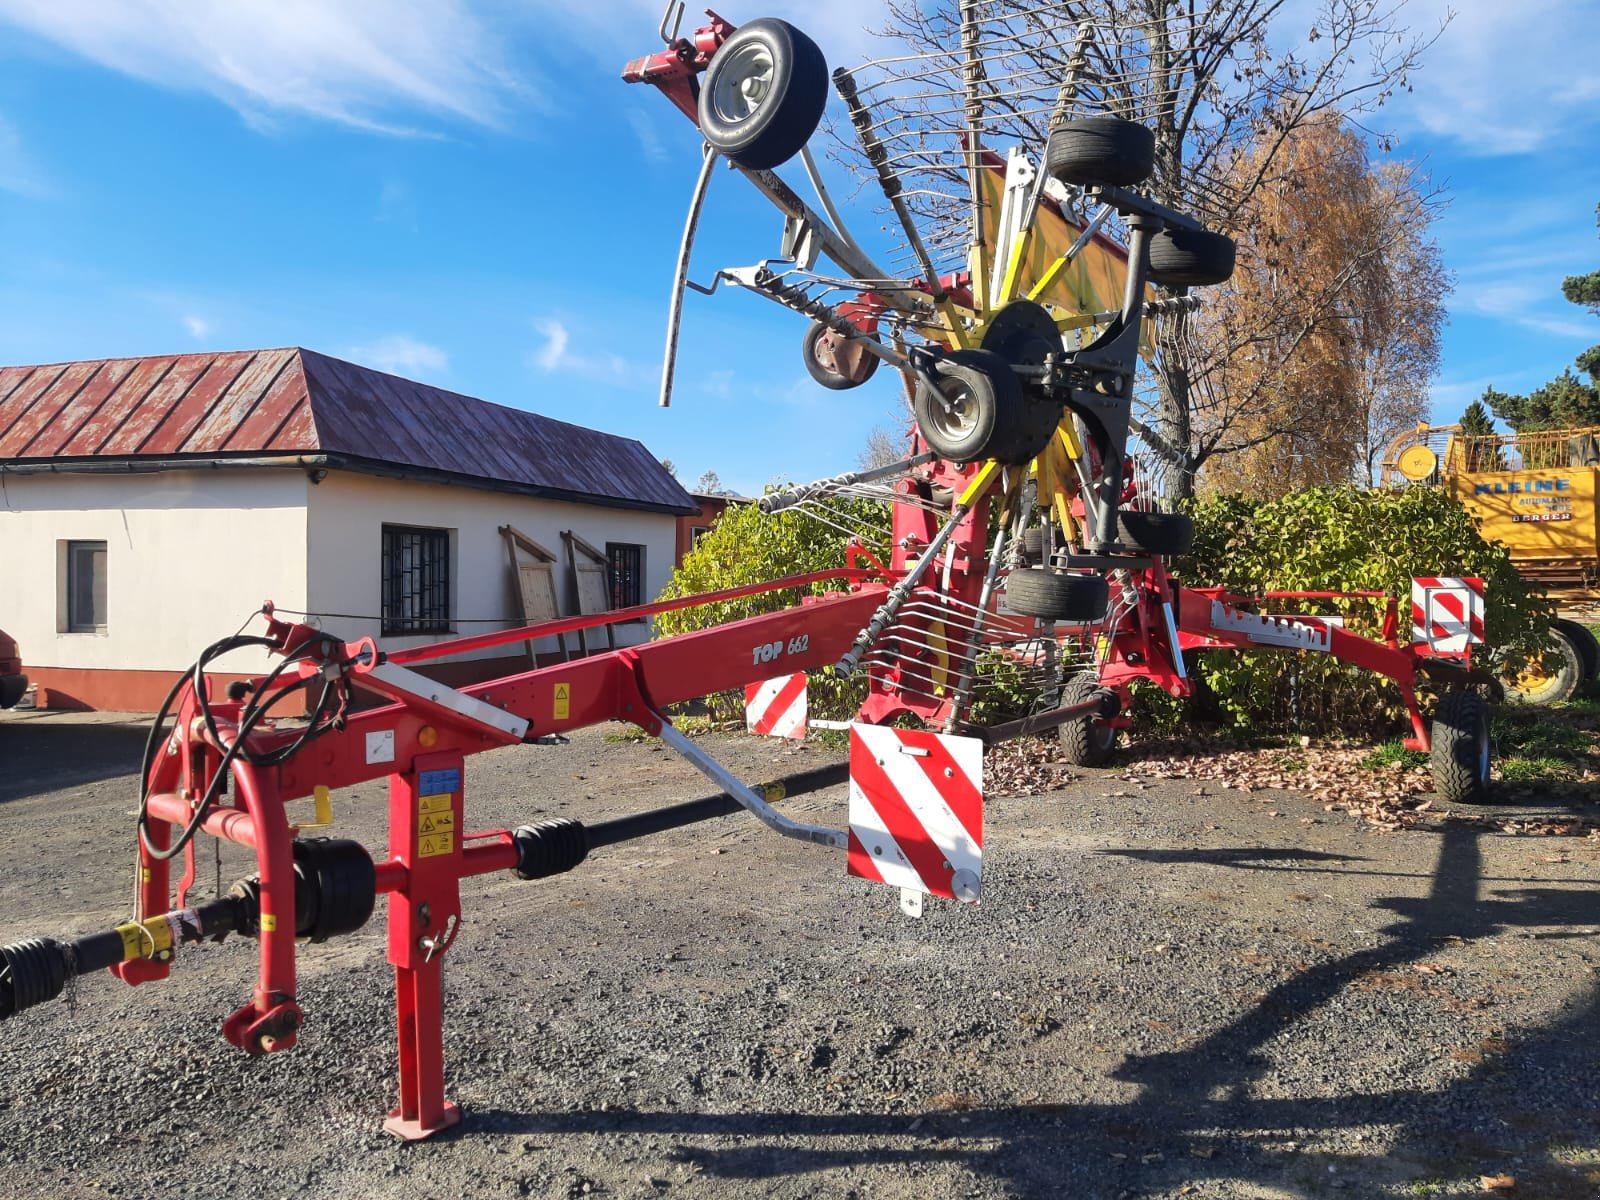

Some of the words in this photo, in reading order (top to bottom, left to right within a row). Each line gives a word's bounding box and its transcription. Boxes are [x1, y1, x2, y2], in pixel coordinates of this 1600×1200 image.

[1474, 479, 1569, 494] KLEINE
[1513, 513, 1571, 522] BERGER
[752, 641, 783, 665] TOP
[788, 634, 809, 655] 662
